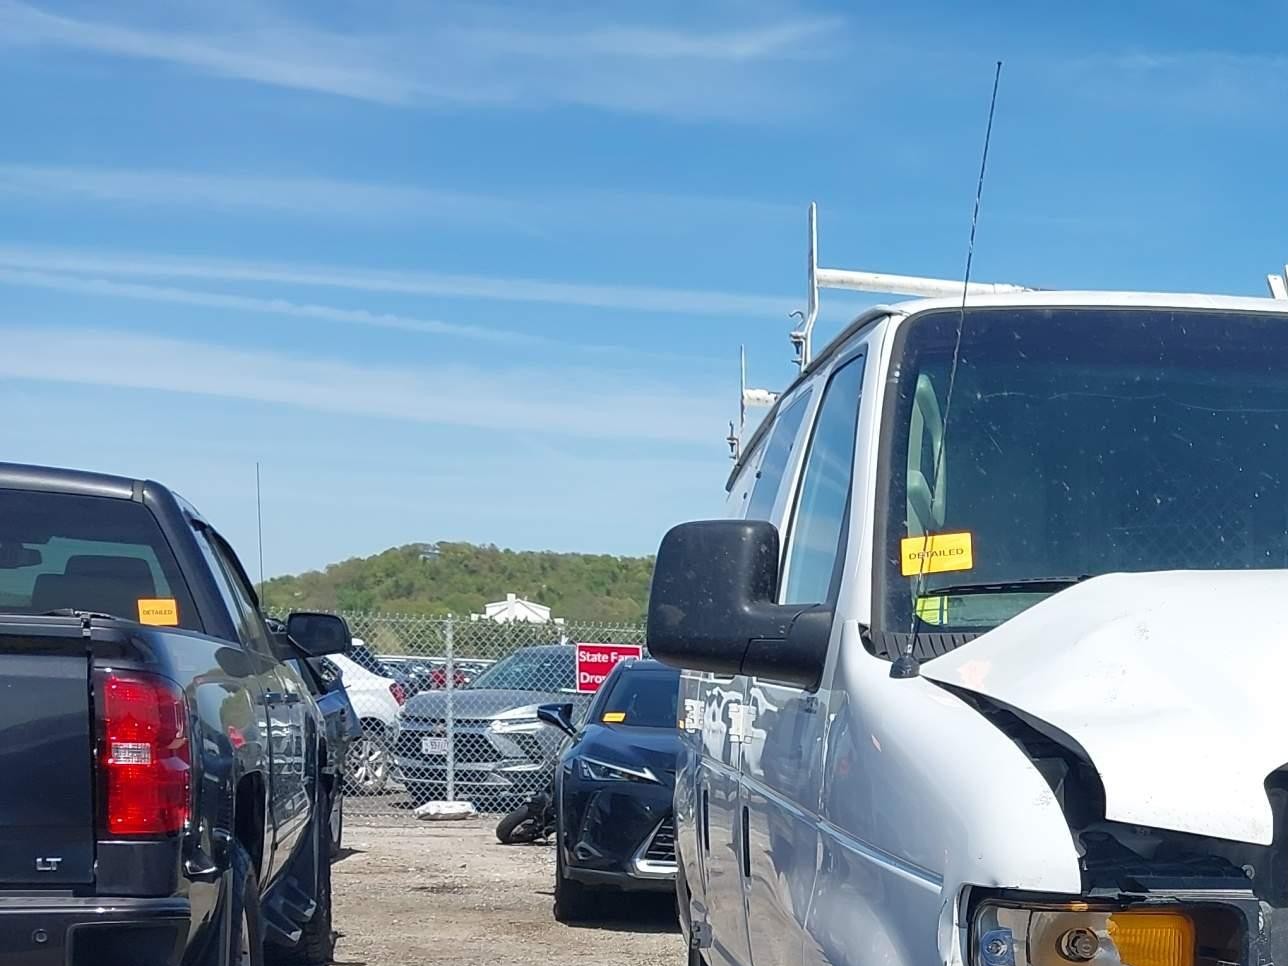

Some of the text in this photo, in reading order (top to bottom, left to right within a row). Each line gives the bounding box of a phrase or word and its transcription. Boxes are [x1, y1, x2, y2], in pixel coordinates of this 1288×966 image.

[908, 548, 965, 561] DETAILED
[579, 650, 609, 663] State
[36, 857, 63, 871] LT
